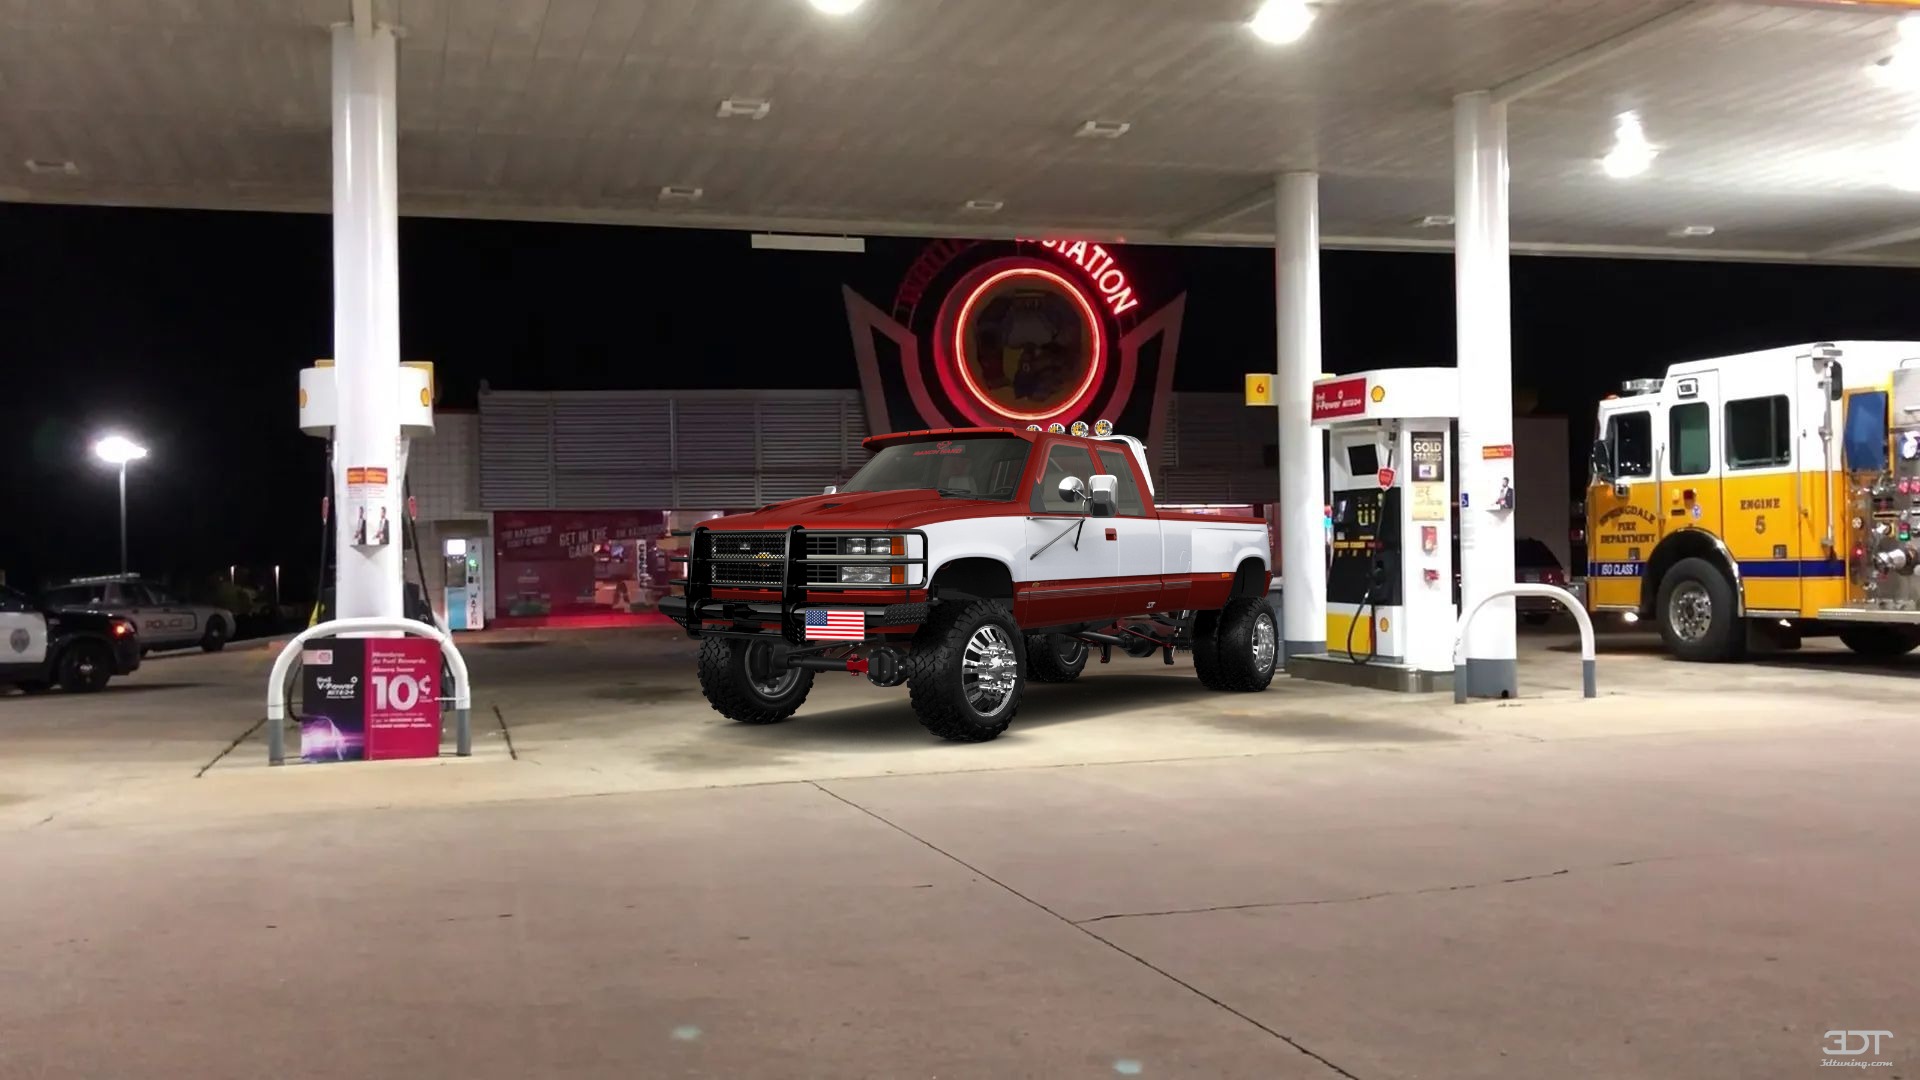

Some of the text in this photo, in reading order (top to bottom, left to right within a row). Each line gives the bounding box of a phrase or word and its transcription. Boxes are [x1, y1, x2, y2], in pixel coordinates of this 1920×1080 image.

[1256, 383, 1265, 394] 6
[1413, 442, 1442, 452] GOLD
[1413, 452, 1442, 461] STATUS
[1740, 498, 1780, 510] ENGINE
[1599, 505, 1656, 527] SPRINGDALE
[1618, 521, 1636, 531] FIRE
[1755, 515, 1766, 535] 5
[560, 532, 576, 547] GET
[578, 530, 589, 543] IN
[591, 526, 608, 542] THE
[1600, 533, 1656, 544] DEPARTMENT
[568, 542, 594, 559] GAME
[1601, 563, 1639, 575] ISO CLASS 1
